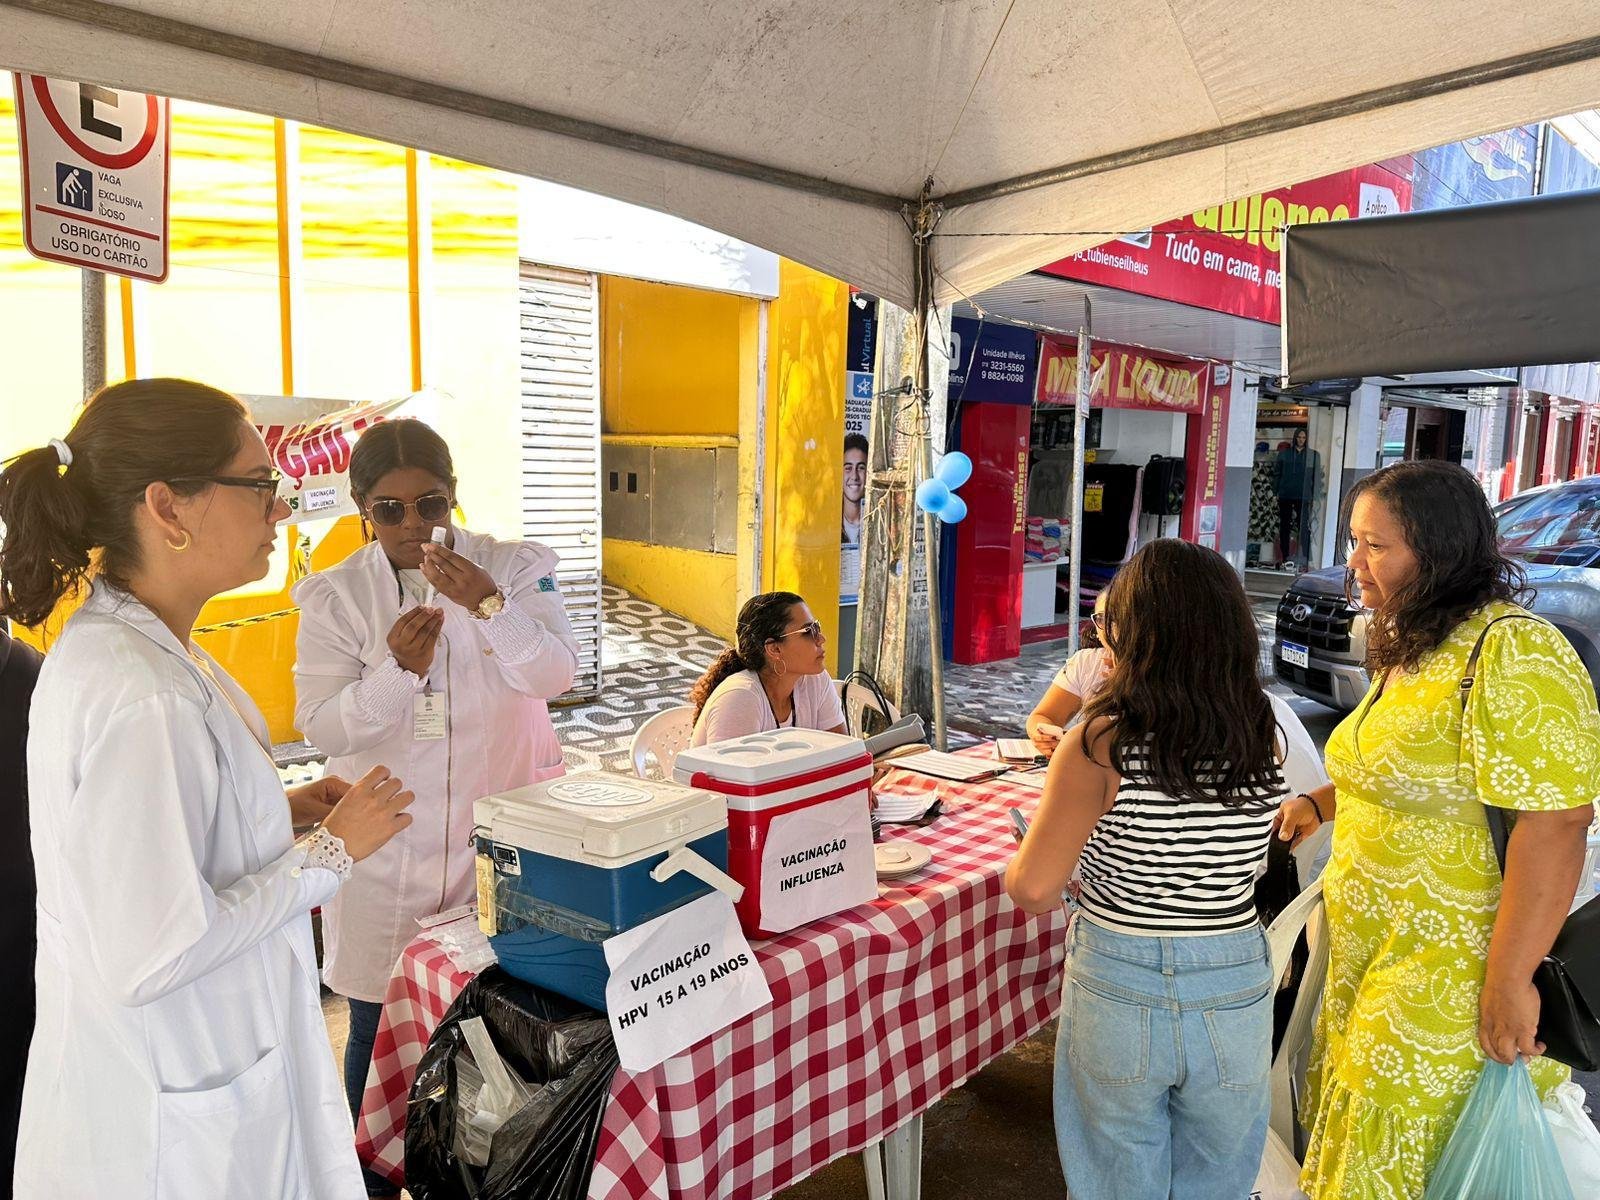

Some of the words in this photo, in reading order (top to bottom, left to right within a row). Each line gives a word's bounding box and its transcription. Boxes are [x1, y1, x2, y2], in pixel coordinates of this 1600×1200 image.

[98, 171, 122, 187] VAGA
[98, 189, 143, 210] EXCLUSIVA
[98, 206, 125, 221] IDOSO
[60, 222, 141, 252] OBRIGATÓRIO
[52, 236, 79, 253] USO
[82, 243, 101, 258] DO
[103, 248, 148, 269] CARTÃO
[1165, 233, 1200, 266] Tudo
[1203, 250, 1224, 272] em
[1226, 256, 1262, 287] cama,
[861, 319, 872, 361] Virtual
[982, 348, 1008, 359] Unidade
[981, 371, 987, 379] 9
[990, 361, 1025, 373] 3231-5560
[1045, 353, 1111, 397] MEA
[845, 421, 863, 431] 025
[780, 838, 847, 868] VACINAÇÃO
[780, 861, 845, 892] INFLUENZA
[630, 942, 711, 992] VACINAÇÃO
[618, 1003, 649, 1030] HPV
[656, 989, 673, 1010] 15
[677, 984, 688, 1000] A
[689, 973, 707, 993] 19
[710, 953, 749, 982] ANOS
